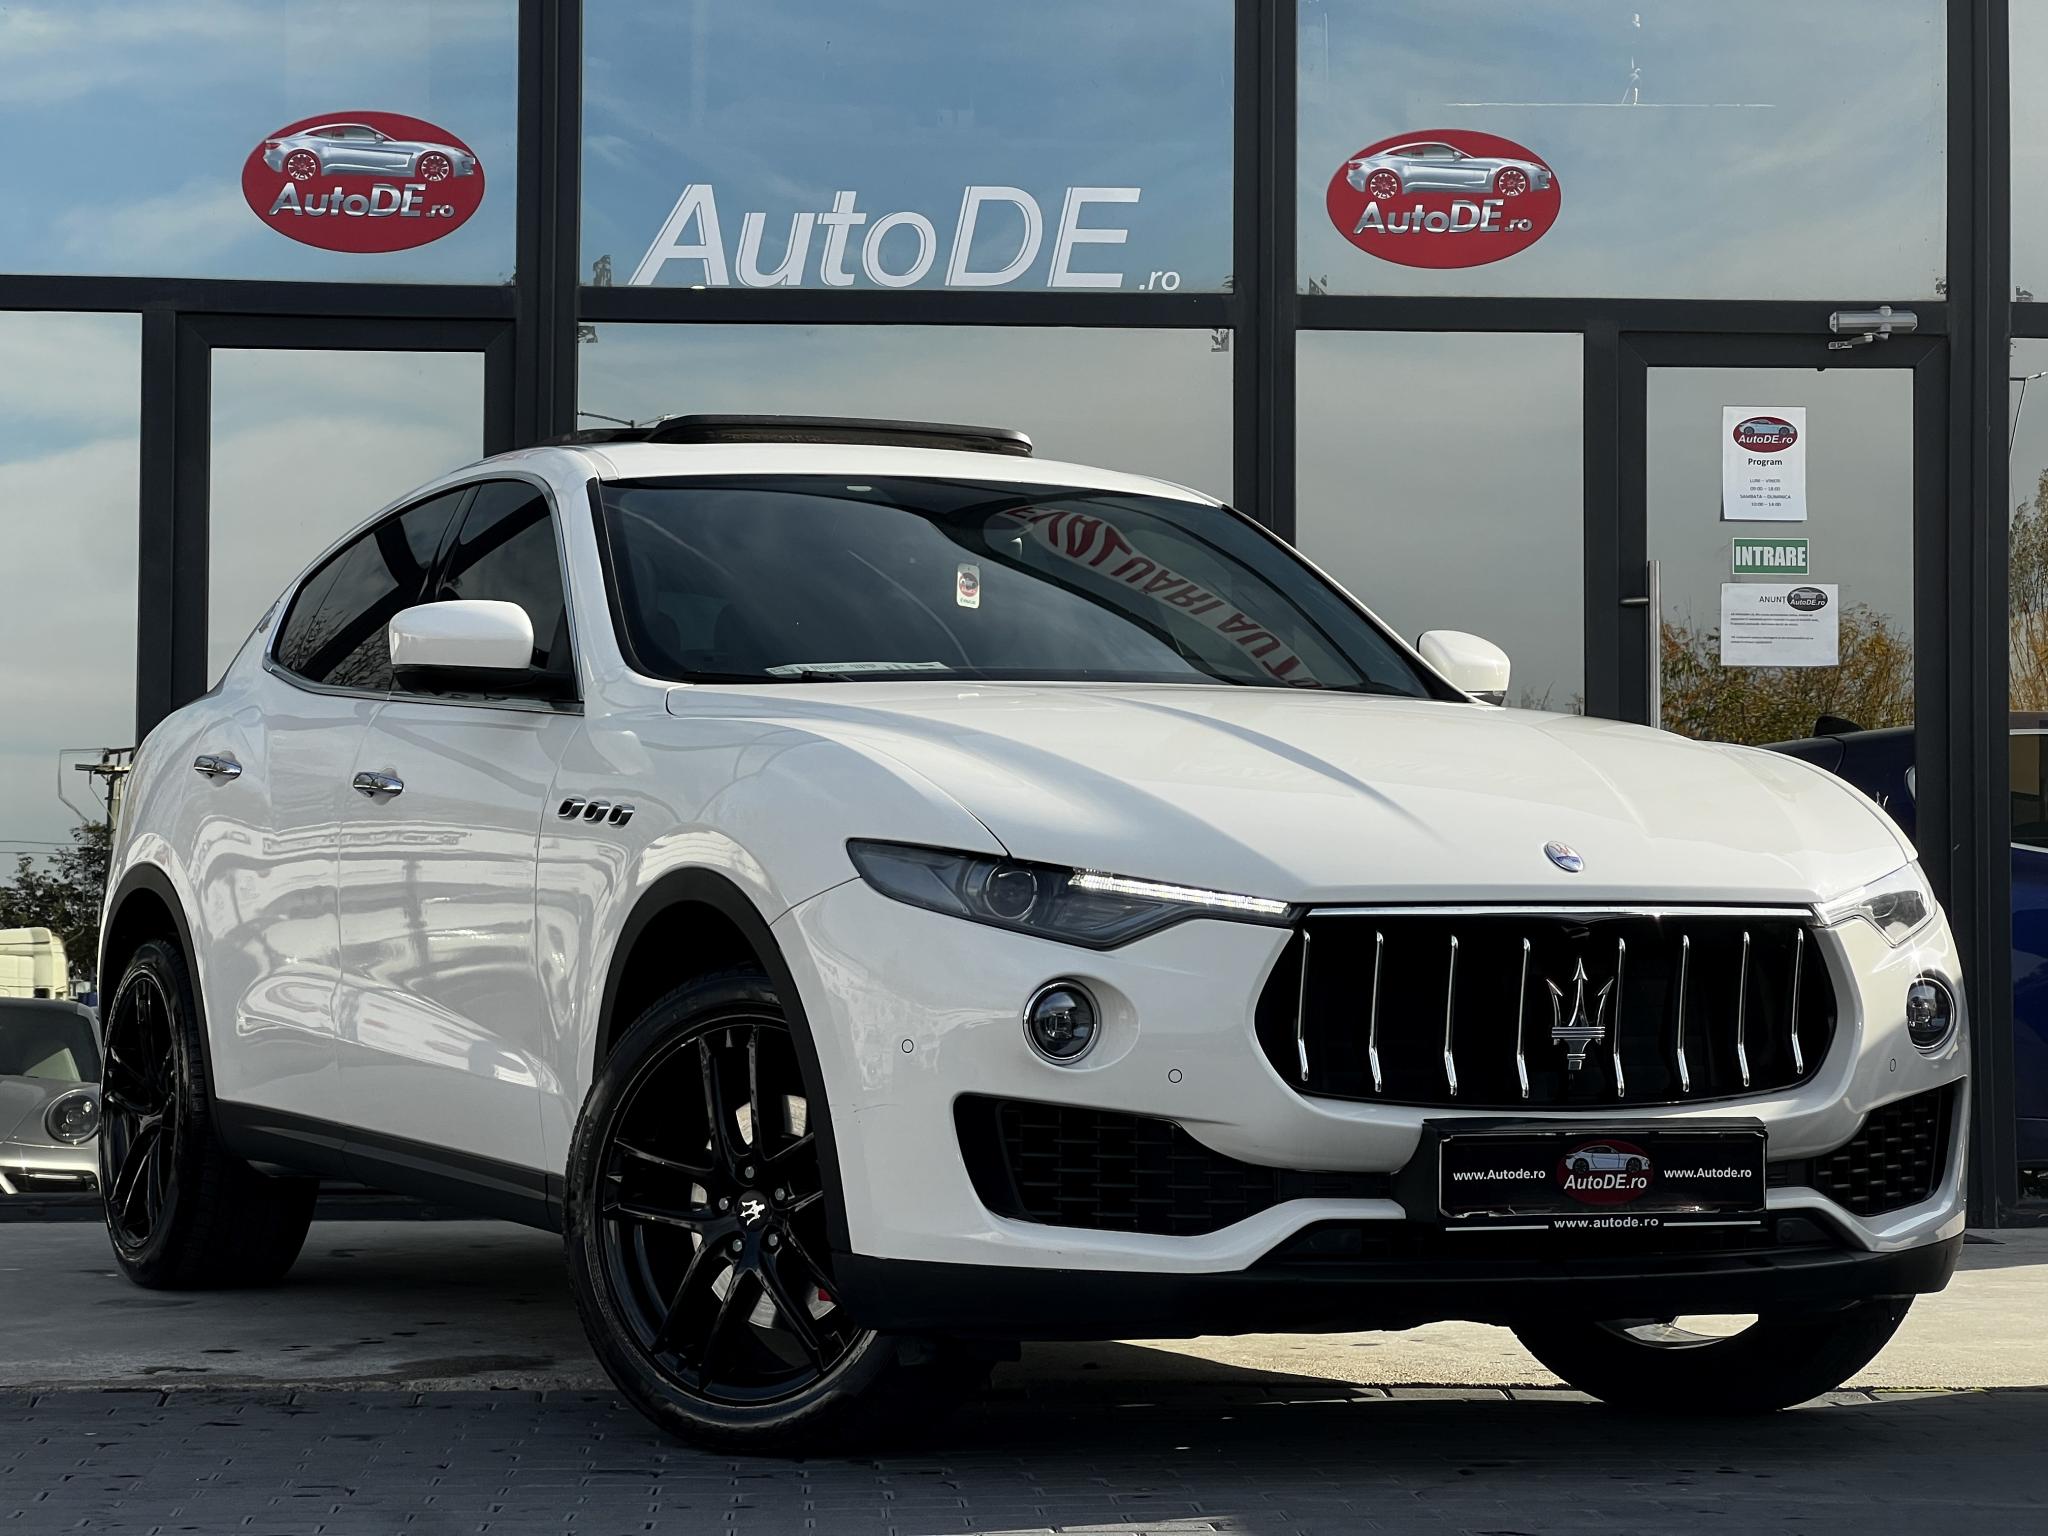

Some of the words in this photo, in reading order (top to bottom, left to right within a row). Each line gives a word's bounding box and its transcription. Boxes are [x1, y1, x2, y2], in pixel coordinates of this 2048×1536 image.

[1738, 434, 1793, 444] AutoDE.ro
[1747, 458, 1783, 467] Program
[1735, 546, 1806, 566] INTRARE
[1452, 1168, 1547, 1181] www.Autode.ro
[1663, 1166, 1752, 1179] www.Autode.ro
[1563, 1173, 1648, 1190] AutoDE.ro
[1553, 1216, 1660, 1229] www.autode.ro
